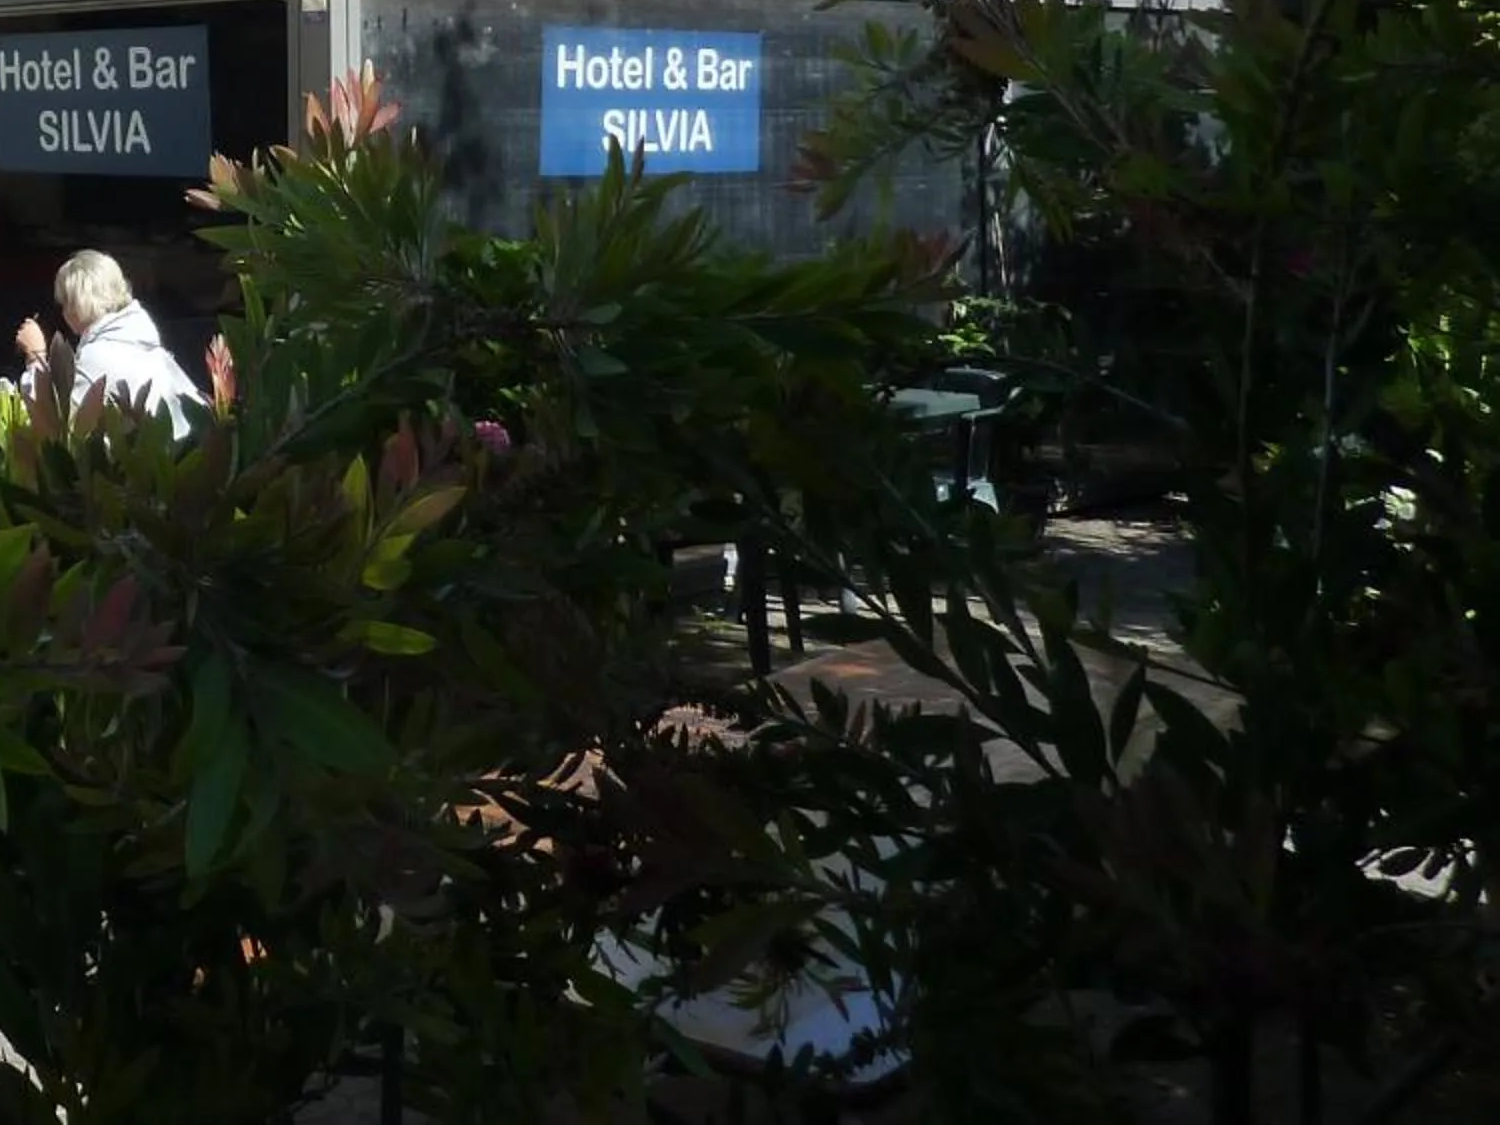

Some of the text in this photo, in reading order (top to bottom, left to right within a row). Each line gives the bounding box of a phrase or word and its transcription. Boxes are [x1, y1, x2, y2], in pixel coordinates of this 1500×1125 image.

[0, 45, 197, 92] Hotel & Bar
[556, 43, 753, 91] Hotel & Bar
[38, 109, 152, 154] SILVIA
[602, 108, 713, 153] SILVIA
